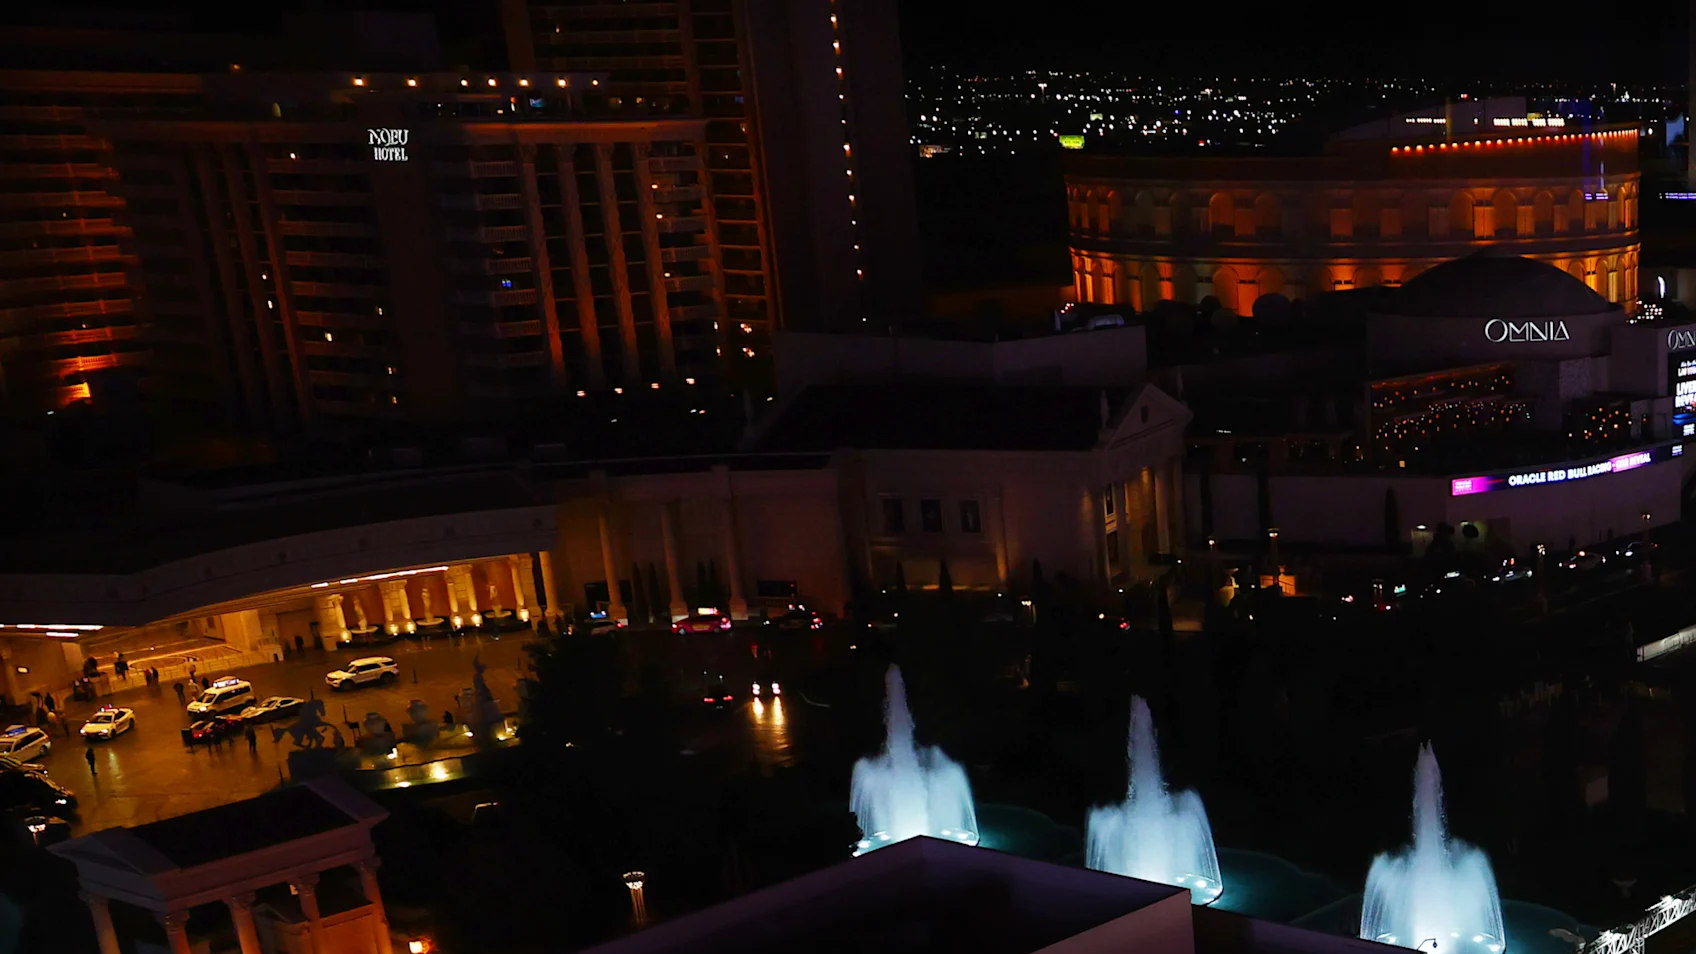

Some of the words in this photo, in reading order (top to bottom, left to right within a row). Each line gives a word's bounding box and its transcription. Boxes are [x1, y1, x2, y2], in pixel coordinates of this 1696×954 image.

[367, 128, 409, 146] NOBU
[373, 147, 409, 161] HOTEL
[1485, 319, 1570, 342] OMNIA
[1508, 471, 1546, 486] ORACLE
[1547, 468, 1566, 482] RED
[1567, 465, 1588, 479] BULL
